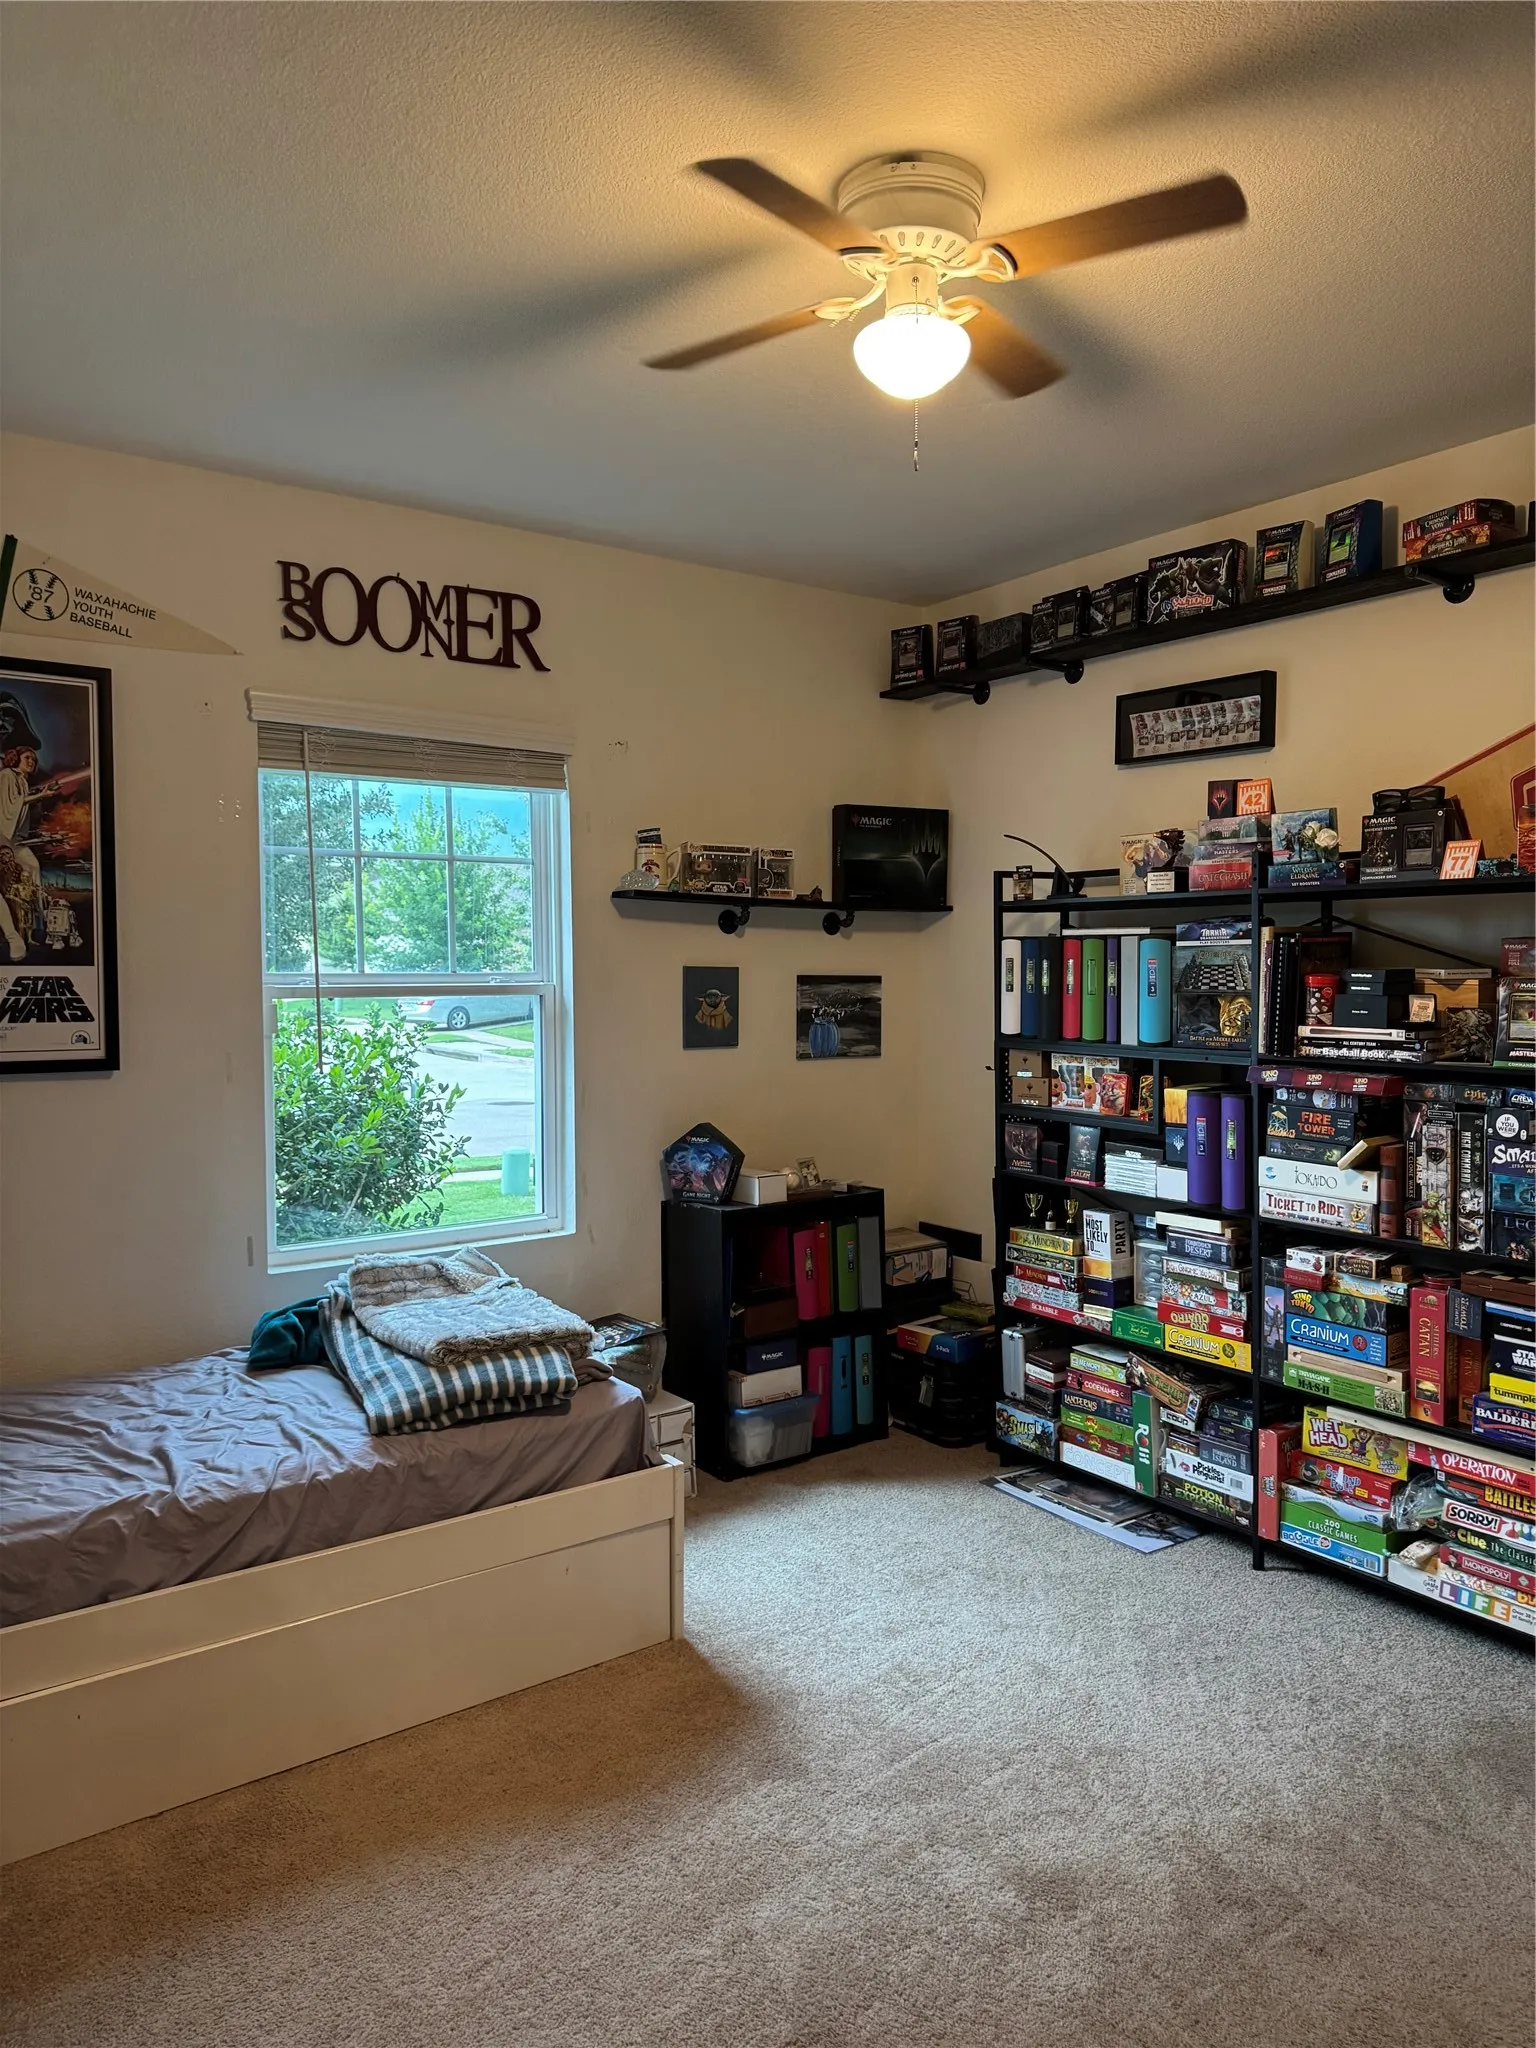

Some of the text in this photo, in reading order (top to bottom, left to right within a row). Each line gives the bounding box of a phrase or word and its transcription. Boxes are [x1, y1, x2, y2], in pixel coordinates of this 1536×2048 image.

[1338, 506, 1356, 517] MAGIC
[1271, 526, 1292, 536] MAGIC
[1156, 556, 1177, 566] MAGIC
[28, 585, 54, 603] '87
[1262, 584, 1287, 595] COMMANDER
[72, 599, 113, 620] YOUTH
[74, 586, 157, 620] WAXAHACHIE
[69, 611, 133, 638] BASEBALL
[1244, 793, 1262, 806] 42
[859, 816, 893, 826] MAGIC
[1369, 815, 1397, 825] MAGIC
[1125, 839, 1144, 847] MAGIC
[1451, 856, 1470, 871] 77
[1198, 871, 1249, 883] GATECRASH
[6, 976, 80, 997] STAR
[0, 997, 95, 1023] WARS
[1321, 1046, 1359, 1059] Baseball
[1360, 1048, 1385, 1059] Book
[1262, 1069, 1278, 1079] UNO
[1301, 1111, 1332, 1126] FIRE
[1297, 1122, 1336, 1135] TOWER
[1460, 1130, 1472, 1184] HIGH COMMAND
[1294, 1166, 1338, 1189] TOKAIDO
[1415, 1155, 1423, 1185] WARS
[1266, 1192, 1345, 1219] TICKET TO RIDE
[1085, 1218, 1103, 1231] MOST
[1086, 1229, 1108, 1244] LIKELY
[1114, 1219, 1127, 1255] PARTY
[1185, 1238, 1212, 1249] FORBIDDEN
[1185, 1244, 1212, 1258] DESERT
[1193, 1293, 1212, 1304] AZUL
[1293, 1292, 1312, 1304] KING
[1031, 1302, 1059, 1316] SCRABBLE
[1290, 1298, 1315, 1314] TOKYO
[1170, 1311, 1209, 1324] QUATRO
[1459, 1297, 1469, 1331] TOWER
[1190, 1321, 1208, 1332] UNO
[1418, 1317, 1431, 1357] CATAN
[766, 1351, 784, 1360] MAGIC
[1083, 1380, 1119, 1397] CODENAMES
[1064, 1394, 1098, 1412] LANTERNS
[1310, 1418, 1342, 1432] WET
[1309, 1430, 1349, 1449] HEAD
[1064, 1446, 1132, 1481] CONCEPT
[1213, 1453, 1238, 1467] ISLAND
[1192, 1464, 1225, 1484] Penguins!
[1197, 1461, 1221, 1477] Pickles
[1442, 1452, 1517, 1485] OPERATION
[1184, 1481, 1223, 1503] POTION
[1174, 1488, 1234, 1517] EXPLOSION
[1325, 1519, 1341, 1530] 100
[1450, 1506, 1499, 1530] SORRY!
[1281, 1530, 1320, 1547] BOGGLE
[1308, 1521, 1358, 1544] CLASSIC GAMES
[1491, 1542, 1504, 1555] The
[1463, 1559, 1510, 1580] MONOPOLY
[1441, 1581, 1509, 1619] LIFE
[1512, 1608, 1524, 1616] Over
[1517, 1615, 1533, 1625] family
